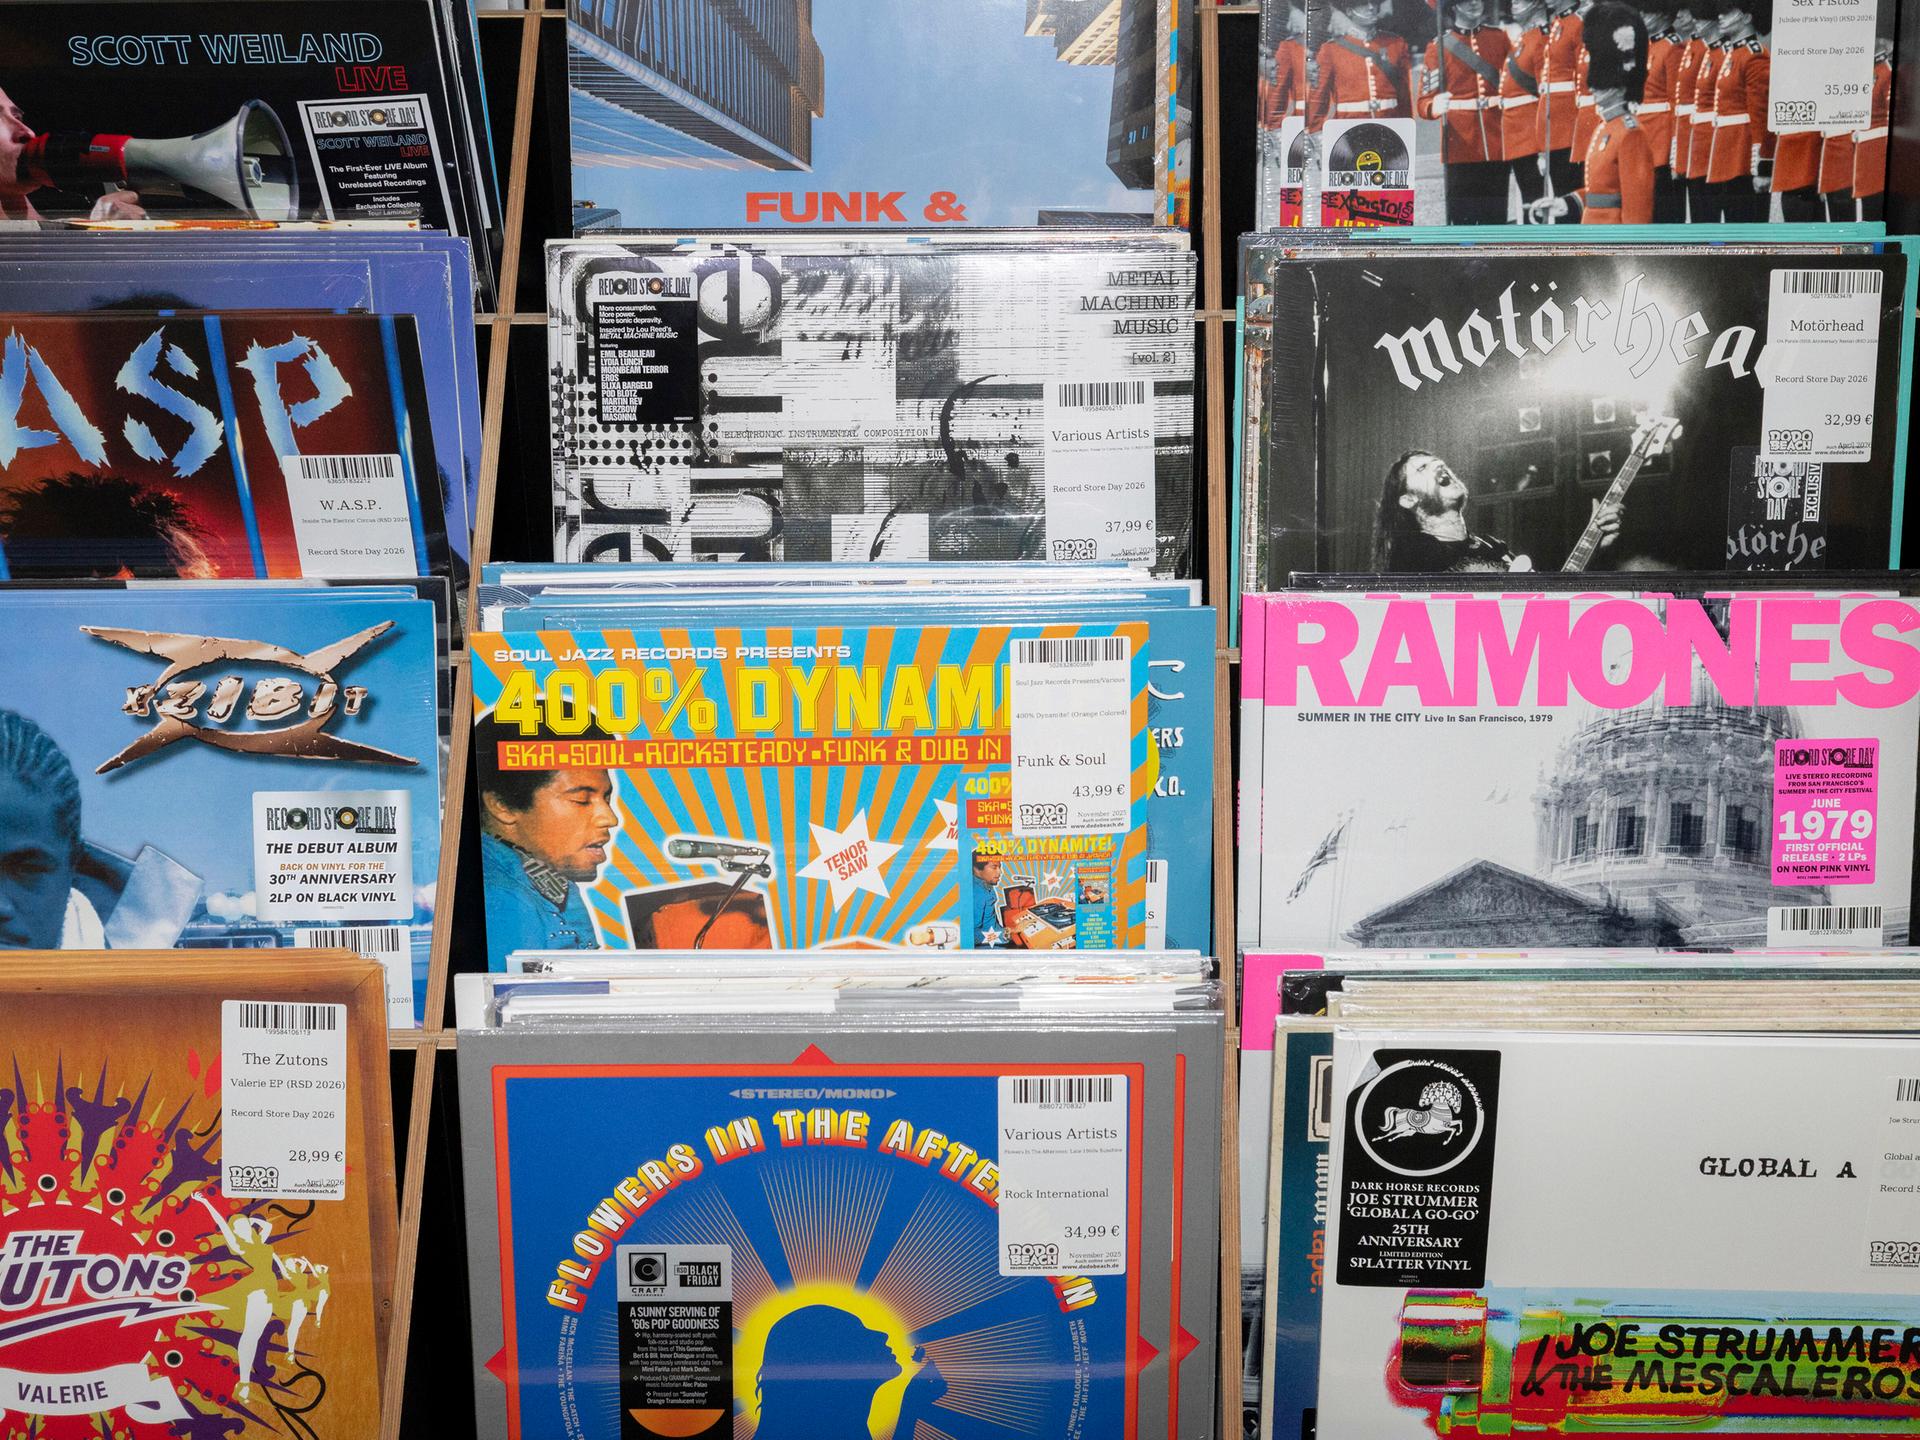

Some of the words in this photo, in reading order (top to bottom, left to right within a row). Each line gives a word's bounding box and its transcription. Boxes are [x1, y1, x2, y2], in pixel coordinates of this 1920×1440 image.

[69, 35, 191, 66] SCOTT
[199, 32, 383, 64] WEILAND
[1807, 47, 1828, 55] Store
[1829, 47, 1844, 57] Day
[1845, 46, 1865, 54] 2026
[335, 66, 408, 92] LIVE
[1824, 84, 1858, 96] 35,99
[1862, 84, 1870, 95] €
[346, 164, 382, 172] First-Ever
[384, 163, 401, 171] LIVE
[403, 161, 428, 170] Album
[364, 171, 397, 180] Featuring
[384, 179, 426, 188] Recordings
[745, 191, 907, 222] FUNK
[923, 191, 969, 222] &
[1106, 270, 1179, 286] METAL
[1080, 295, 1179, 311] MACHINE
[1113, 319, 1179, 335] MUSIC
[1790, 319, 1864, 332] Motörhead
[600, 350, 618, 358] EMIL
[618, 350, 655, 358] BEAULIEAU
[1132, 352, 1159, 364] [vol.
[1162, 351, 1176, 364] 2]
[620, 358, 643, 366] LUNCH
[600, 366, 641, 374] MOONBEAM
[642, 365, 669, 374] TERROR
[1775, 375, 1804, 383] Record
[1806, 375, 1828, 383] Store
[1830, 375, 1846, 385] Day
[1847, 375, 1868, 383] 2026
[1824, 414, 1861, 427] 32,99
[1864, 414, 1873, 425] €
[788, 428, 859, 439] INSTRUMENTAL
[863, 428, 929, 438] COMPOSITION
[1052, 430, 1102, 442] Various
[1105, 428, 1150, 440] Artists
[1053, 485, 1082, 493] Record
[1083, 484, 1105, 492] Store
[1108, 483, 1123, 493] Day
[1125, 481, 1145, 490] 2026
[320, 499, 382, 511] W.A.S.P.
[1105, 520, 1142, 533] 37,99
[1145, 519, 1153, 531] €
[494, 648, 553, 662] SOUL
[559, 648, 614, 662] JAZZ
[621, 647, 728, 661] RECORDS
[735, 645, 851, 660] PRESENTS
[1266, 598, 1920, 710] RAMONES
[494, 667, 719, 736] 400%
[1298, 712, 1350, 722] SUMMER
[1354, 712, 1365, 722] IN
[1370, 712, 1391, 722] THE
[1395, 712, 1421, 722] CITY
[1425, 713, 1444, 722] Live
[1447, 713, 1456, 722] In
[1459, 714, 1476, 722] San
[1479, 713, 1527, 723] Francisco,
[1529, 713, 1553, 722] 1979
[1017, 755, 1054, 768] Funk
[1059, 754, 1070, 767] &
[1075, 753, 1106, 767] Soul
[1072, 784, 1112, 798] 43,99
[1117, 784, 1125, 796] €
[1019, 803, 1068, 817] DODO
[1811, 798, 1841, 809] JUNE
[1020, 814, 1067, 826] BEACH
[1778, 810, 1873, 841] 1979
[266, 843, 293, 854] THE
[297, 843, 344, 854] DEBUT
[347, 842, 398, 854] ALBUM
[1785, 843, 1815, 852] FIRST
[1817, 842, 1864, 851] OFFICIAL
[824, 840, 868, 872] TENOR
[1782, 854, 1829, 863] RELEASE
[1838, 853, 1846, 862] 2
[1848, 853, 1867, 862] LPs
[279, 863, 304, 871] BACK
[348, 862, 366, 870] FOR
[368, 862, 385, 870] THE
[838, 854, 869, 881] SAW
[1792, 865, 1818, 873] NEON
[1820, 865, 1841, 873] PINK
[1844, 864, 1870, 872] VINYL
[270, 873, 296, 885] 30TH
[300, 873, 397, 884] ANNIVERSARY
[270, 893, 292, 903] 2LP
[296, 893, 313, 903] ON
[318, 893, 358, 903] BLACK
[361, 892, 397, 902] VINYL
[242, 1053, 271, 1065] The
[275, 1053, 328, 1066] Zutons
[230, 1078, 267, 1088] Valerie
[269, 1079, 284, 1088] EP
[286, 1079, 313, 1090] (RSD
[315, 1080, 346, 1091] 2026)
[741, 1089, 886, 1100] STEREO/MONO
[1004, 1128, 1062, 1140] Various
[1066, 1127, 1118, 1140] Artists
[288, 1150, 330, 1164] 28,99
[334, 1150, 343, 1162] €
[1699, 1156, 1818, 1178] GLOBAL
[1836, 1161, 1857, 1178] A
[1005, 1189, 1033, 1199] Rock
[1036, 1188, 1109, 1199] International
[1351, 1181, 1384, 1191] DARK
[1386, 1182, 1423, 1192] HORSE
[1426, 1184, 1480, 1194] RECORDS
[1348, 1193, 1379, 1206] JOE
[1382, 1194, 1479, 1208] STRUMMER
[546, 1143, 704, 1313] FLOWERS
[704, 1116, 766, 1165] IN
[773, 1108, 870, 1149] THE
[878, 1118, 999, 1213] AFTE
[1413, 1209, 1423, 1220] A
[1064, 1225, 1106, 1239] 34,99
[1111, 1225, 1120, 1238] €
[1392, 1224, 1430, 1235] 25TH
[12, 1235, 75, 1258] THE
[1358, 1235, 1462, 1248] ANNIVERSARY
[690, 1265, 719, 1275] BLACK
[1350, 1257, 1423, 1270] SPLATTER
[1427, 1259, 1471, 1271] VINYL
[0, 1254, 186, 1306] UTONS
[687, 1276, 719, 1286] FRIDAY
[630, 1307, 637, 1317] A
[638, 1307, 668, 1317] SUNNY
[669, 1306, 707, 1317] SERVING
[708, 1306, 720, 1317] OF
[651, 1319, 670, 1330] POP
[672, 1319, 719, 1330] GOODNESS
[1556, 1323, 1641, 1358] JOE
[1655, 1324, 1920, 1364] STRUMMER
[1557, 1364, 1613, 1391] THE
[1624, 1360, 1920, 1400] MESCALEROS
[18, 1381, 109, 1405] VALERIE
